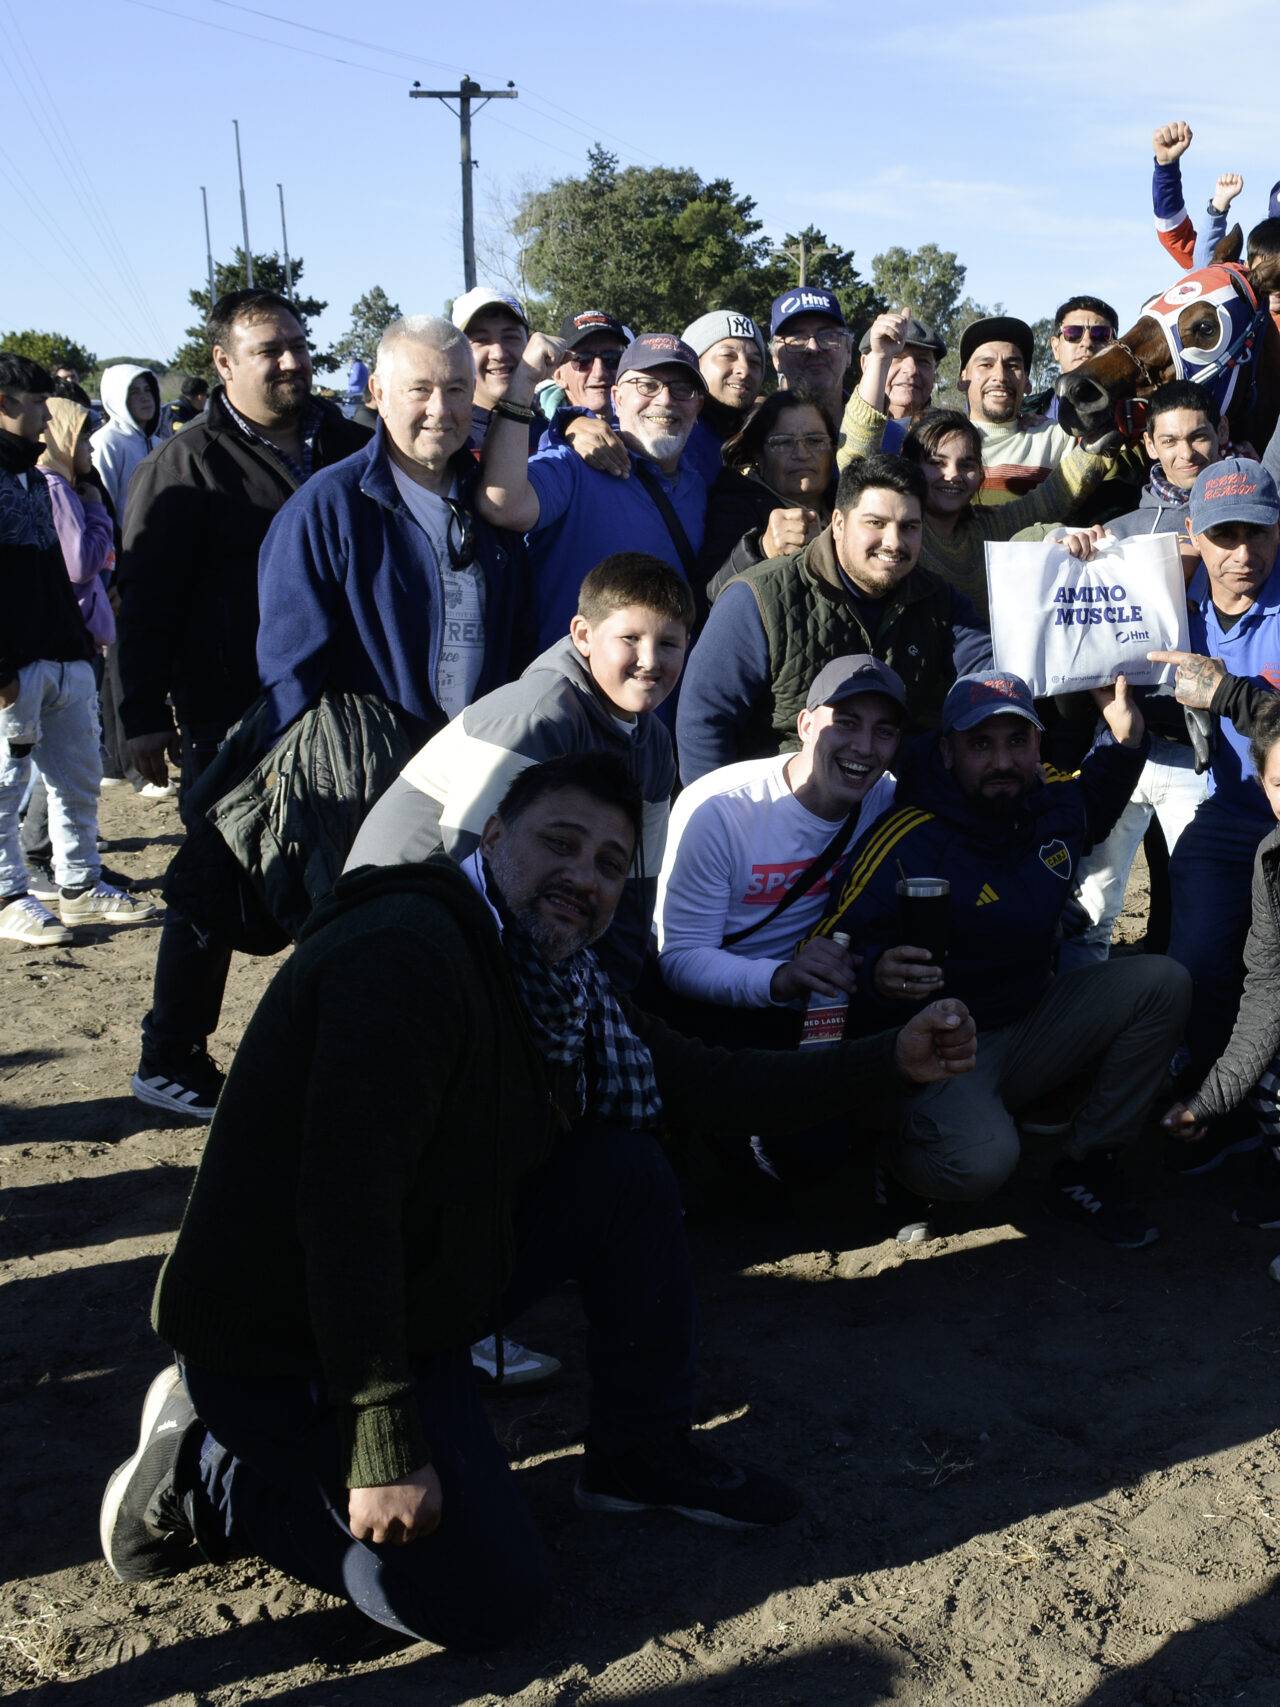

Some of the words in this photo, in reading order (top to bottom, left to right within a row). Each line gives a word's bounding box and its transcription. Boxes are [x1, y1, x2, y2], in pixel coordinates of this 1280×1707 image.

[801, 293, 830, 308] Hnt
[733, 317, 752, 335] NY
[1204, 484, 1257, 502] REASON
[1053, 585, 1127, 604] AMINO
[1055, 606, 1143, 625] MUSCLE
[1130, 630, 1150, 640] Hnt
[1046, 850, 1067, 868] CABJ
